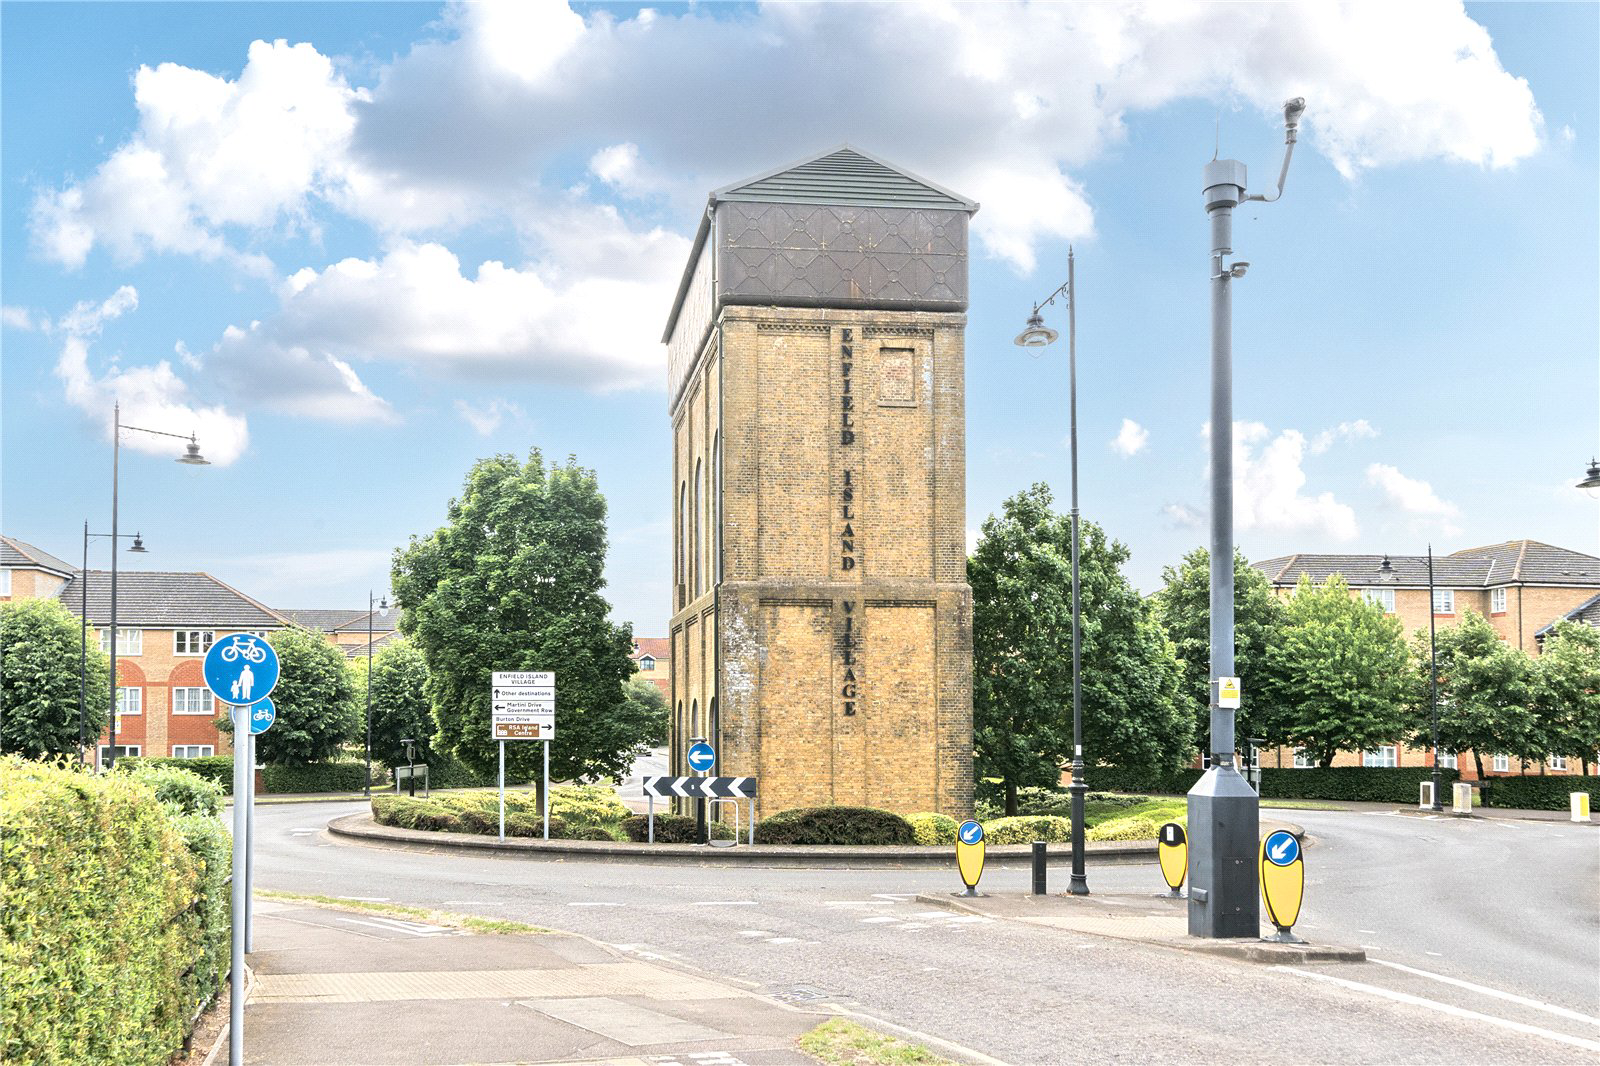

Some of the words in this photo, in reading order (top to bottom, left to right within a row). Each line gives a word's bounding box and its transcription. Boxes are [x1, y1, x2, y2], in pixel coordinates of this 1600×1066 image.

[841, 328, 855, 445] ENFIELD
[841, 469, 855, 571] ISLAND
[842, 601, 856, 716] VILLAGE
